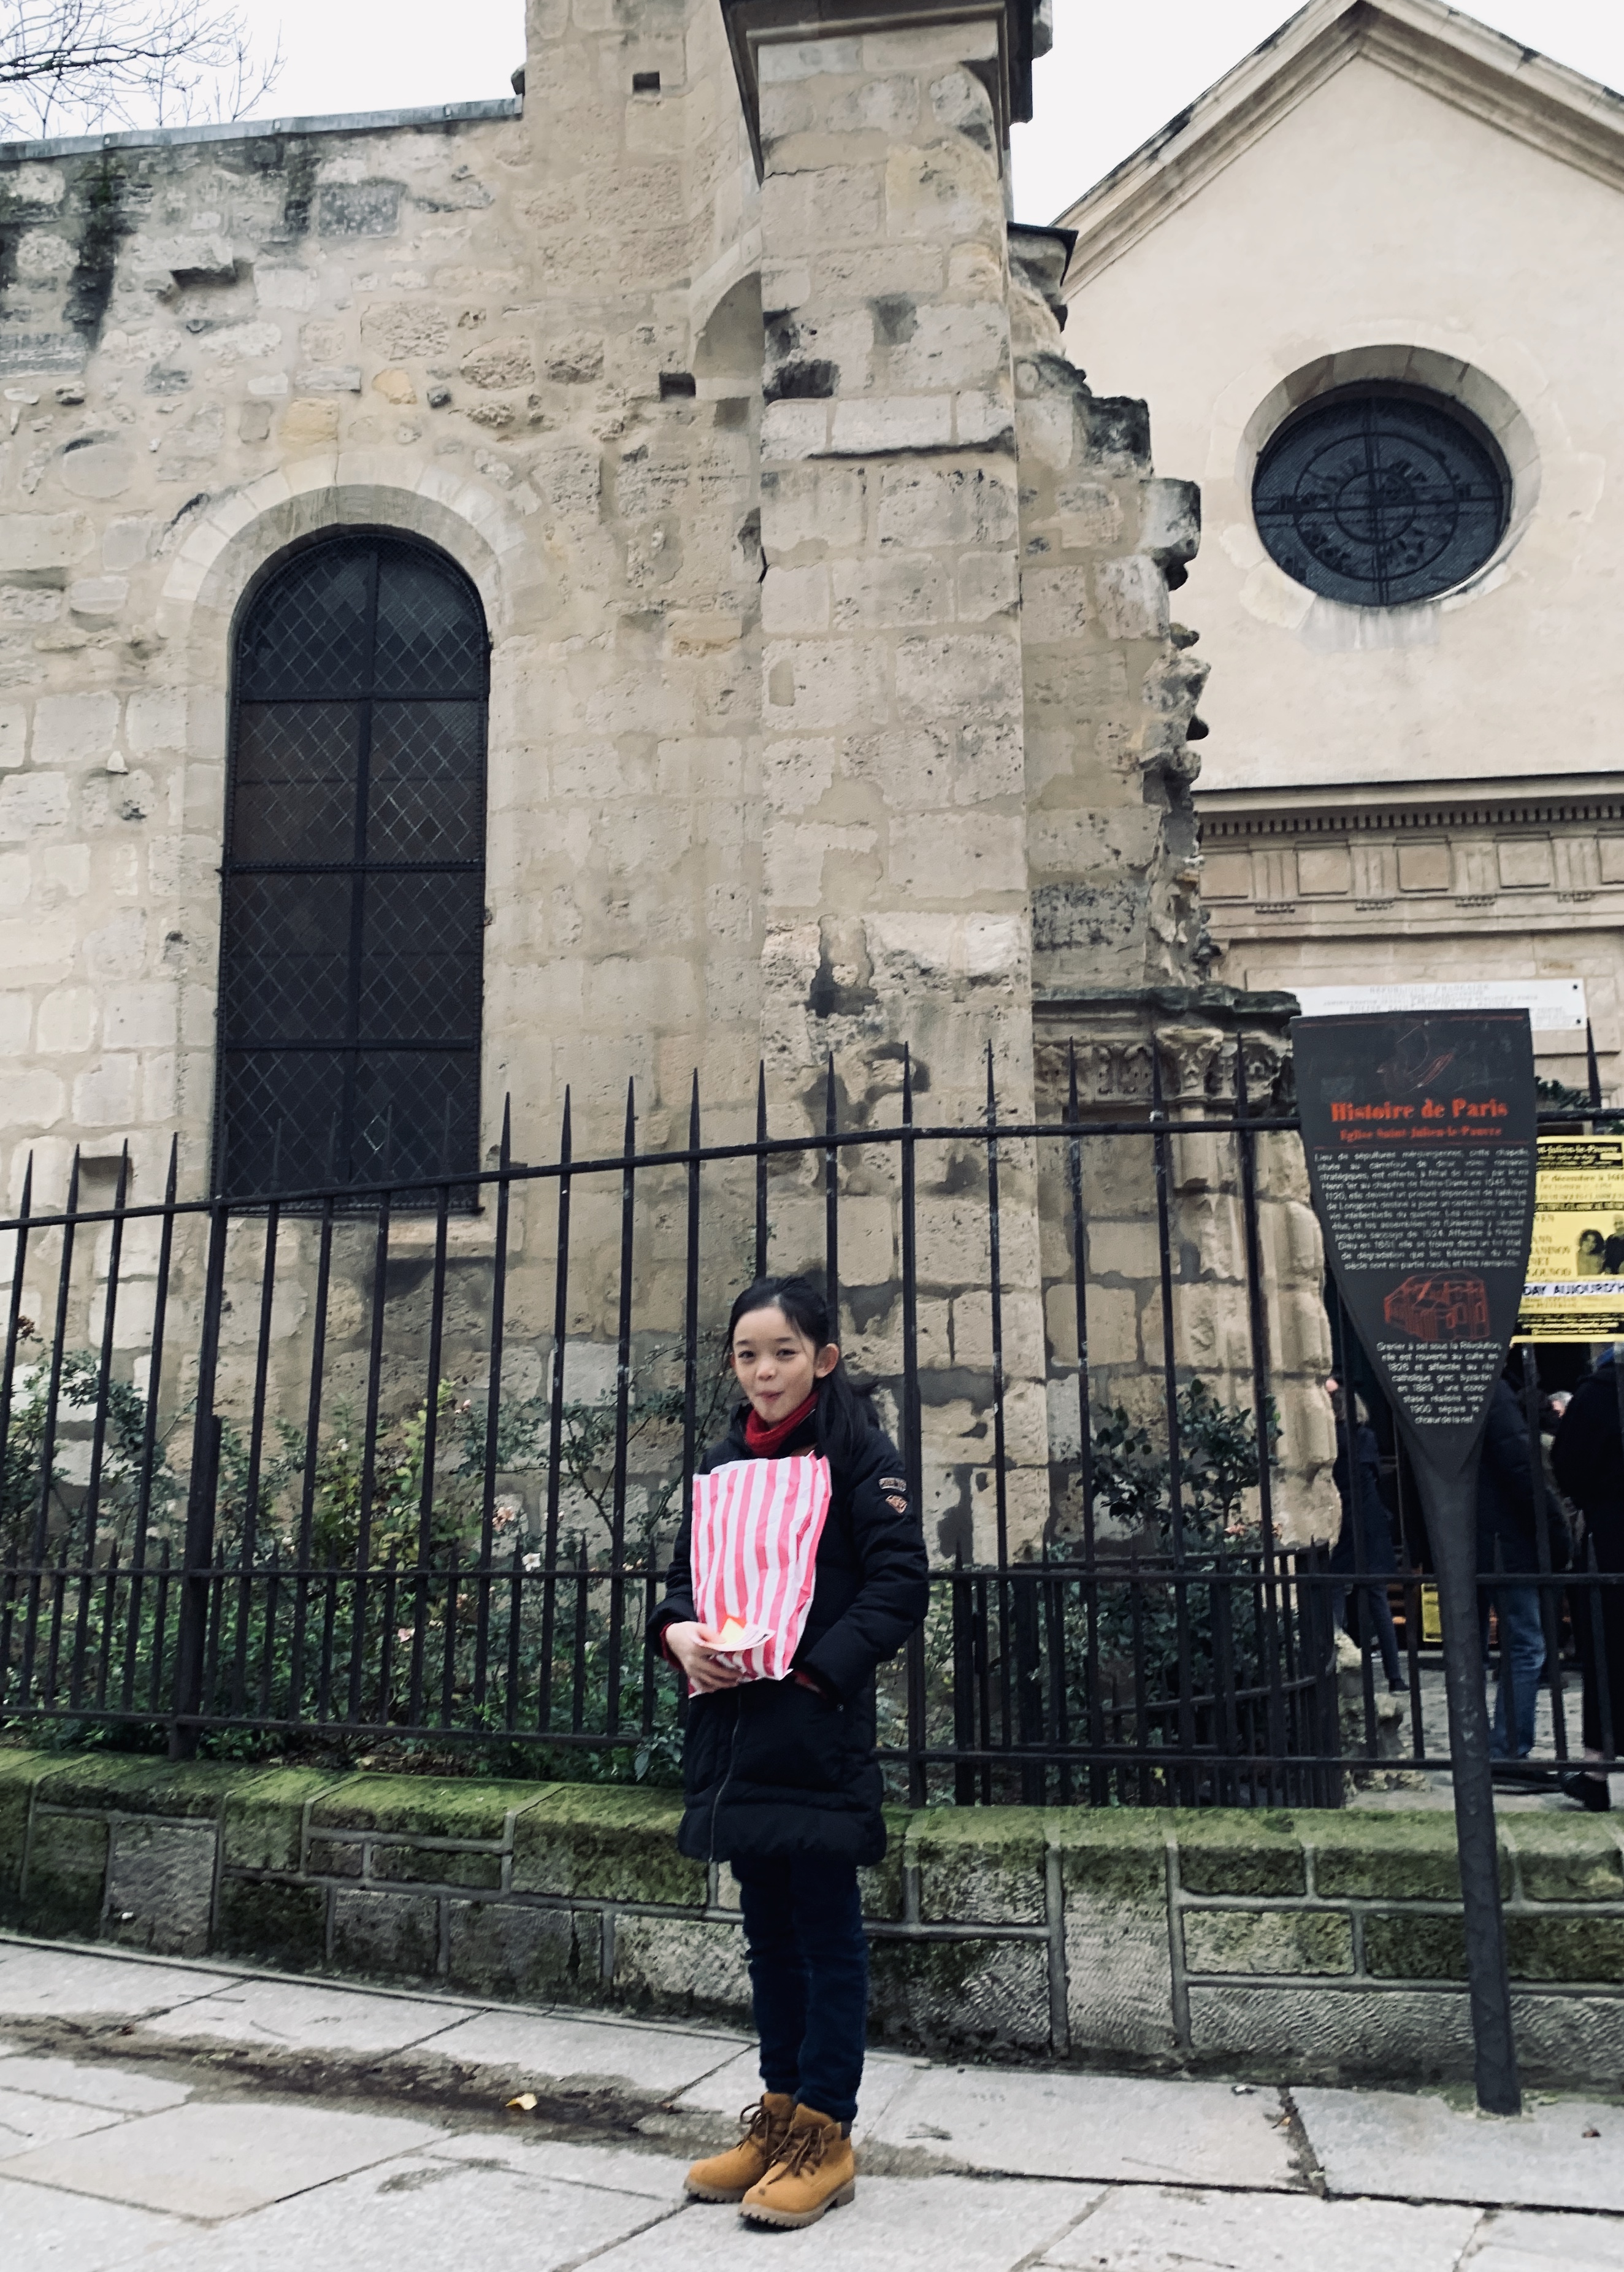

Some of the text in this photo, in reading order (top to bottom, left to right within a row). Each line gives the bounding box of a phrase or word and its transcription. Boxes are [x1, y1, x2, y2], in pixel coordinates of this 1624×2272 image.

[1331, 1097, 1509, 1122] Histoire de Paris
[1523, 1286, 1547, 1296] DAY
